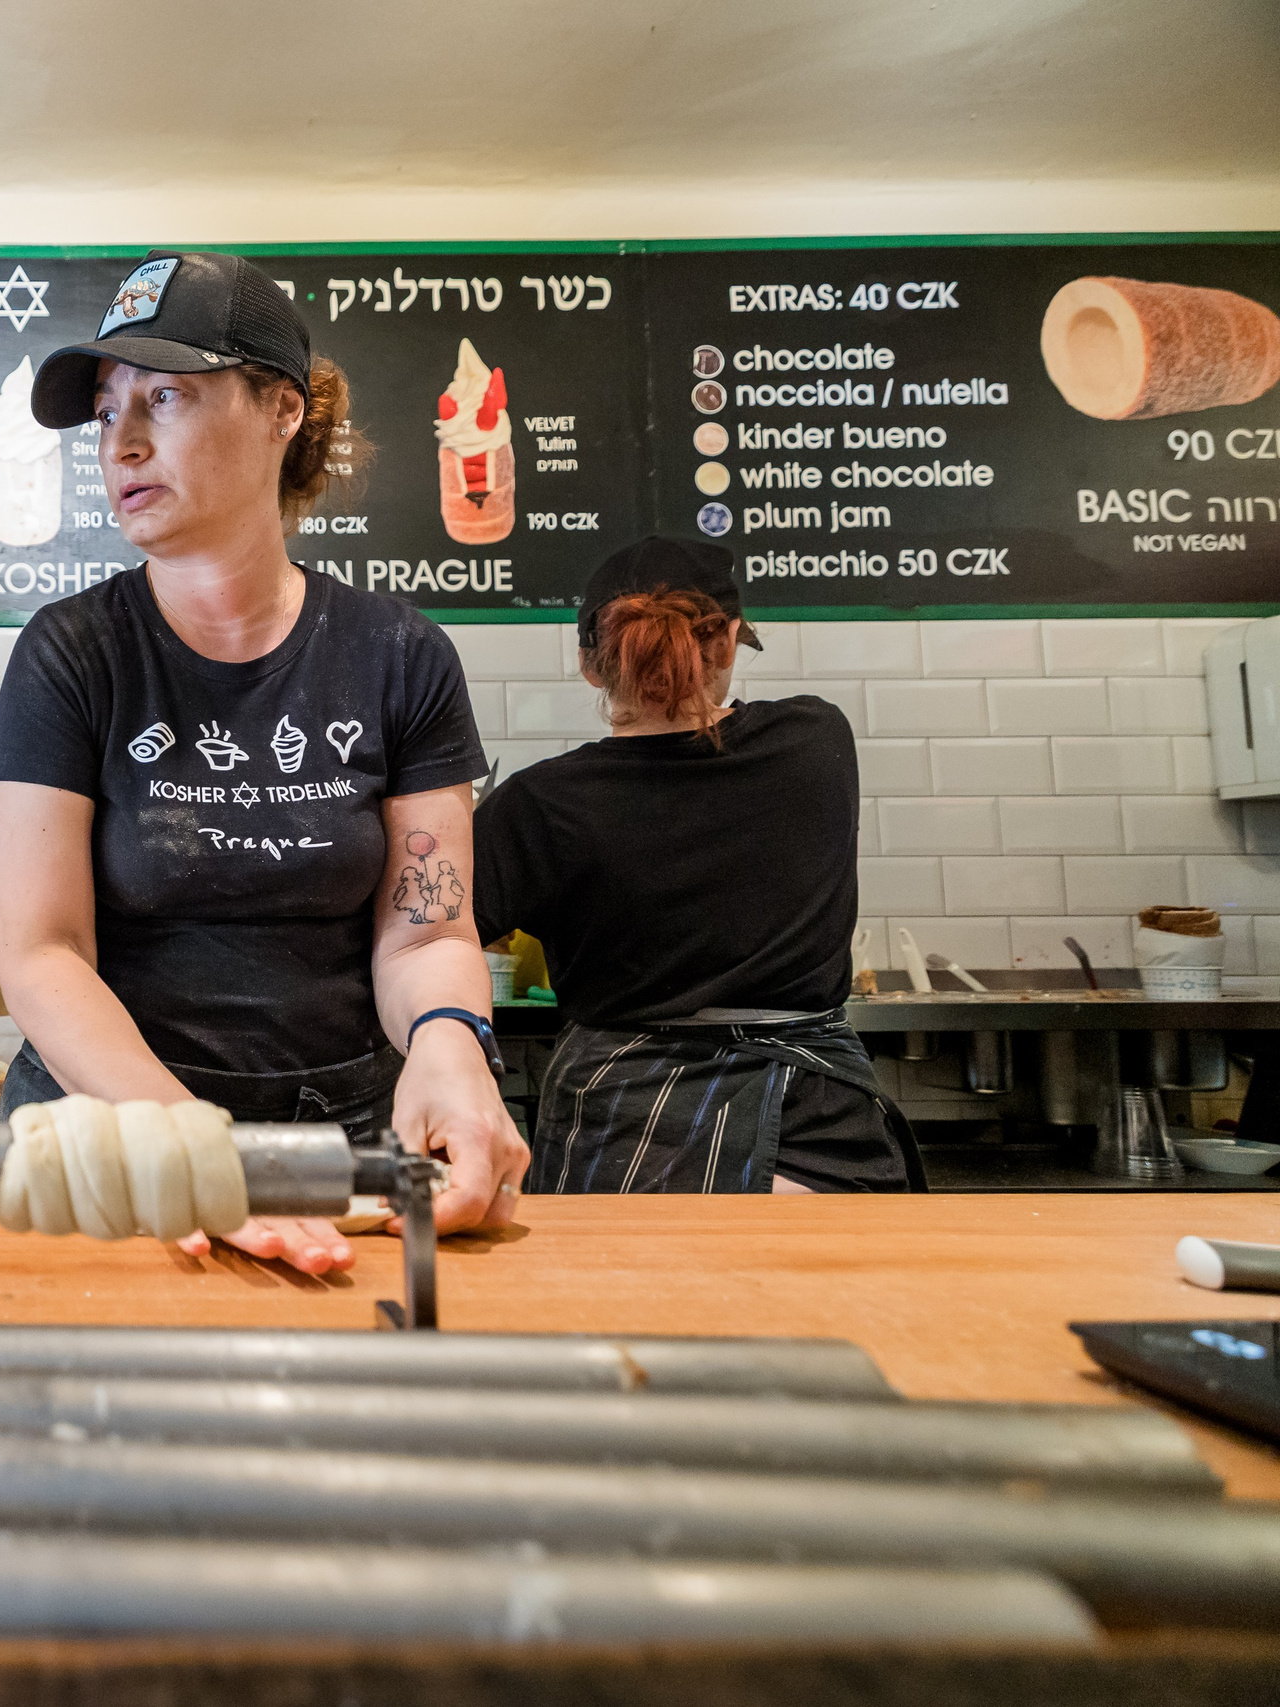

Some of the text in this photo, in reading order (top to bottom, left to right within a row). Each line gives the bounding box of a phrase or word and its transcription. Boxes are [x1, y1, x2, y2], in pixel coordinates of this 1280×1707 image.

[140, 262, 169, 277] CHILL
[327, 266, 504, 322] טרדלניק
[520, 274, 613, 312] כשר
[729, 281, 959, 312] EXTRAS: 40 CZK
[732, 343, 895, 372] chocolate
[735, 379, 877, 408] nocciola
[902, 378, 1009, 406] nutella
[523, 416, 576, 432] VELVET
[738, 421, 948, 450] kinder bueno
[71, 441, 99, 457] Stru
[536, 436, 577, 452] Tutim
[1167, 428, 1280, 462] 90 CZ
[740, 460, 994, 490] white chocolate
[71, 511, 103, 529] 180
[743, 501, 892, 534] plum jam
[1077, 488, 1193, 523] BASIC
[1207, 496, 1280, 523] רווה
[297, 516, 369, 534] 180 CZK
[526, 512, 600, 530] 190 CZK
[1133, 533, 1246, 552] NOT VEGAN
[366, 558, 514, 592] PRAGUE
[746, 548, 1011, 582] pistachio 50 CZK
[149, 776, 358, 804] KOSHER TRDELNÍK
[198, 828, 334, 860] Prague
